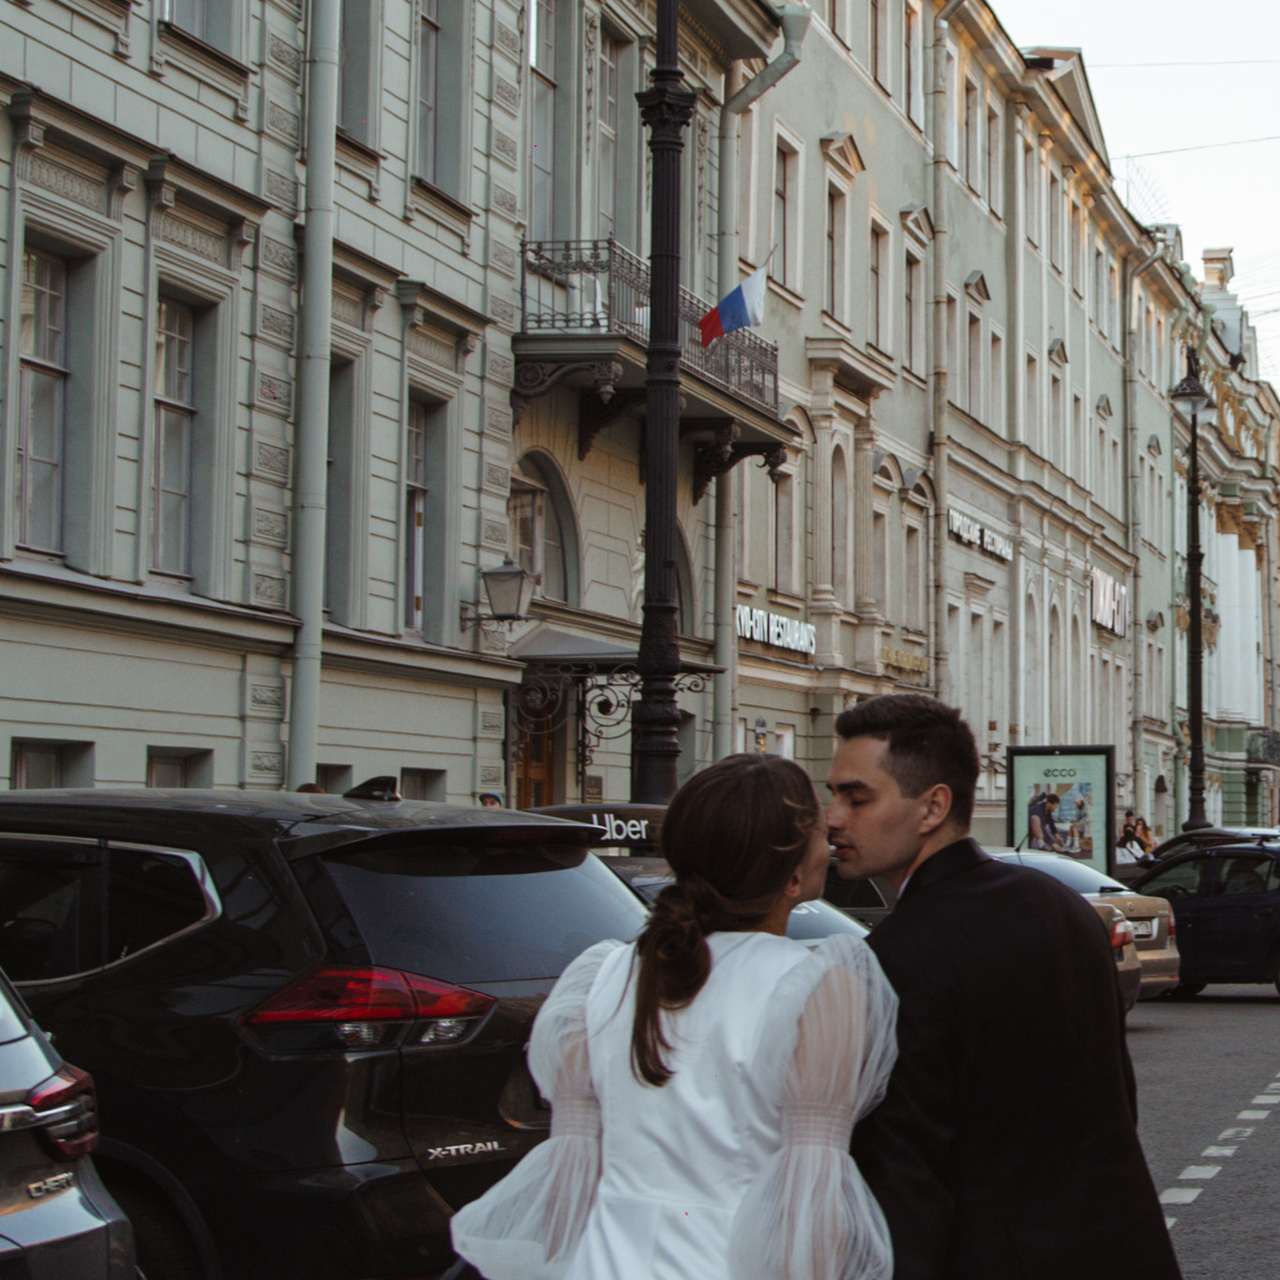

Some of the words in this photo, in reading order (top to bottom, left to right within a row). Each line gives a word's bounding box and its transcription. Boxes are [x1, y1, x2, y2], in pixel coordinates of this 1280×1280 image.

[1043, 768, 1076, 778] ecco
[592, 813, 649, 840] Uber
[427, 1141, 506, 1160] X-TRAIL
